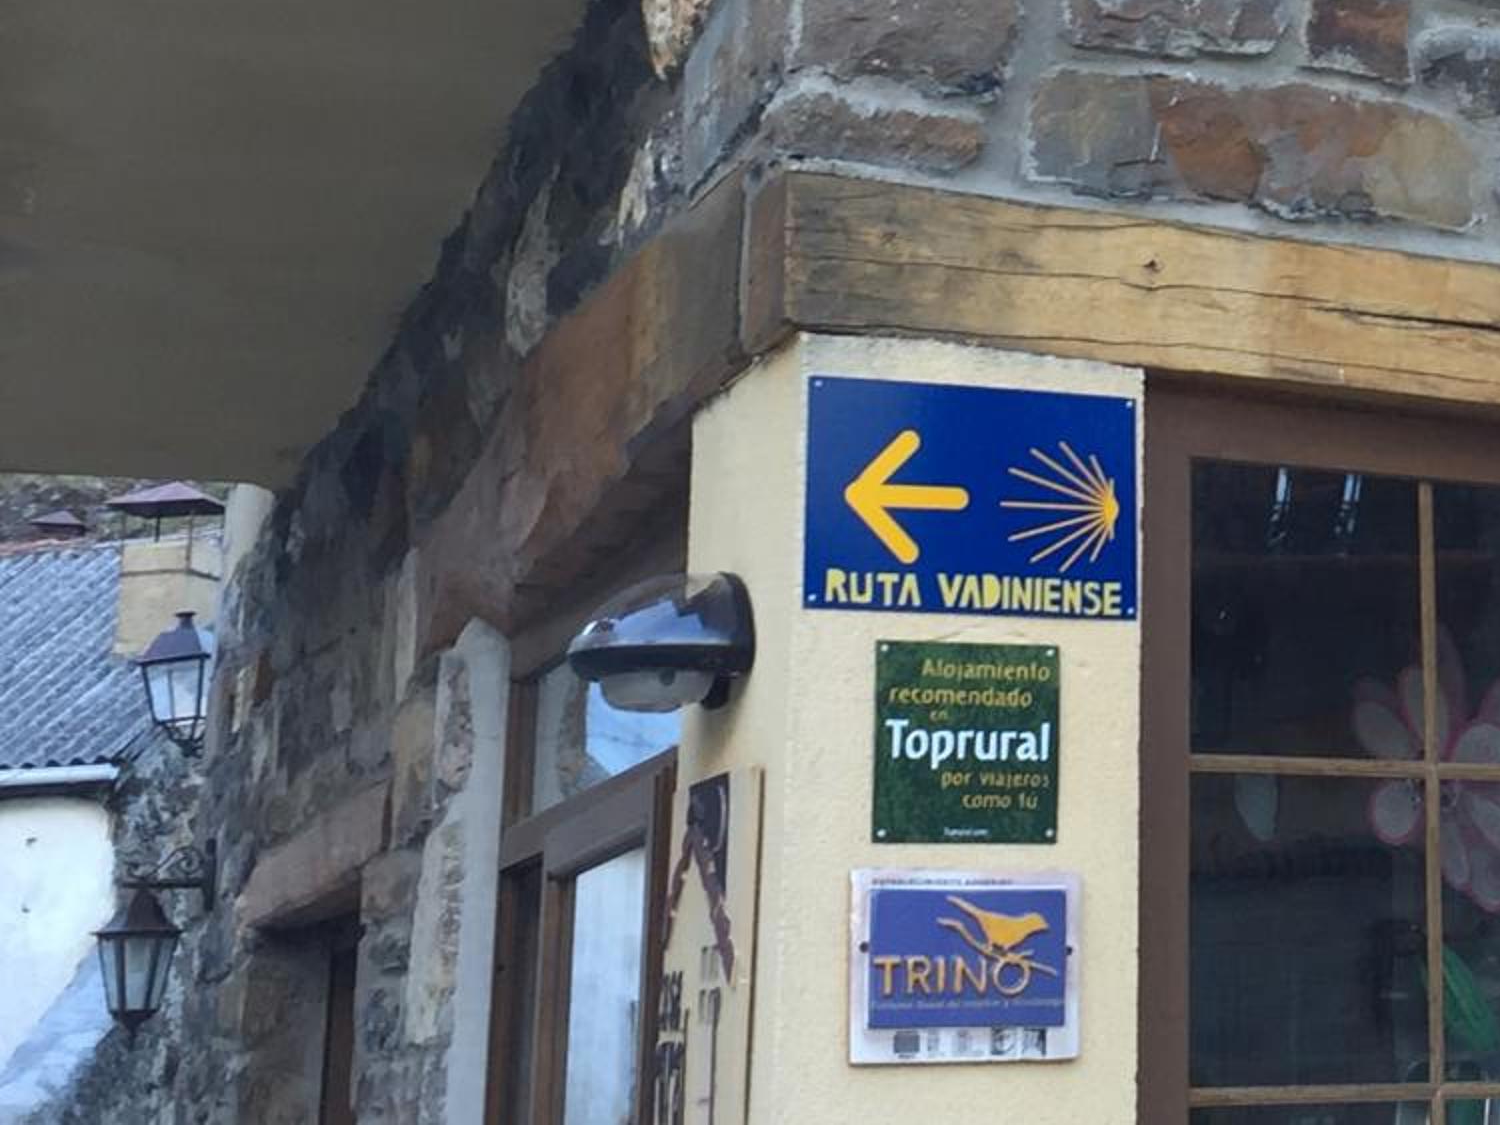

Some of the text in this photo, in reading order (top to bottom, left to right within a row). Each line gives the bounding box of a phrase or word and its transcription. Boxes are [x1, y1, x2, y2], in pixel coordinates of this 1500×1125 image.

[825, 568, 1122, 615] RUTA VADINIENSE
[921, 658, 1051, 682] Alojamiento
[888, 686, 1033, 708] recomendado
[885, 718, 1051, 770] Toprural
[941, 770, 1050, 790] por viajeros
[962, 793, 1012, 809] como
[872, 955, 1031, 996] TRINO
